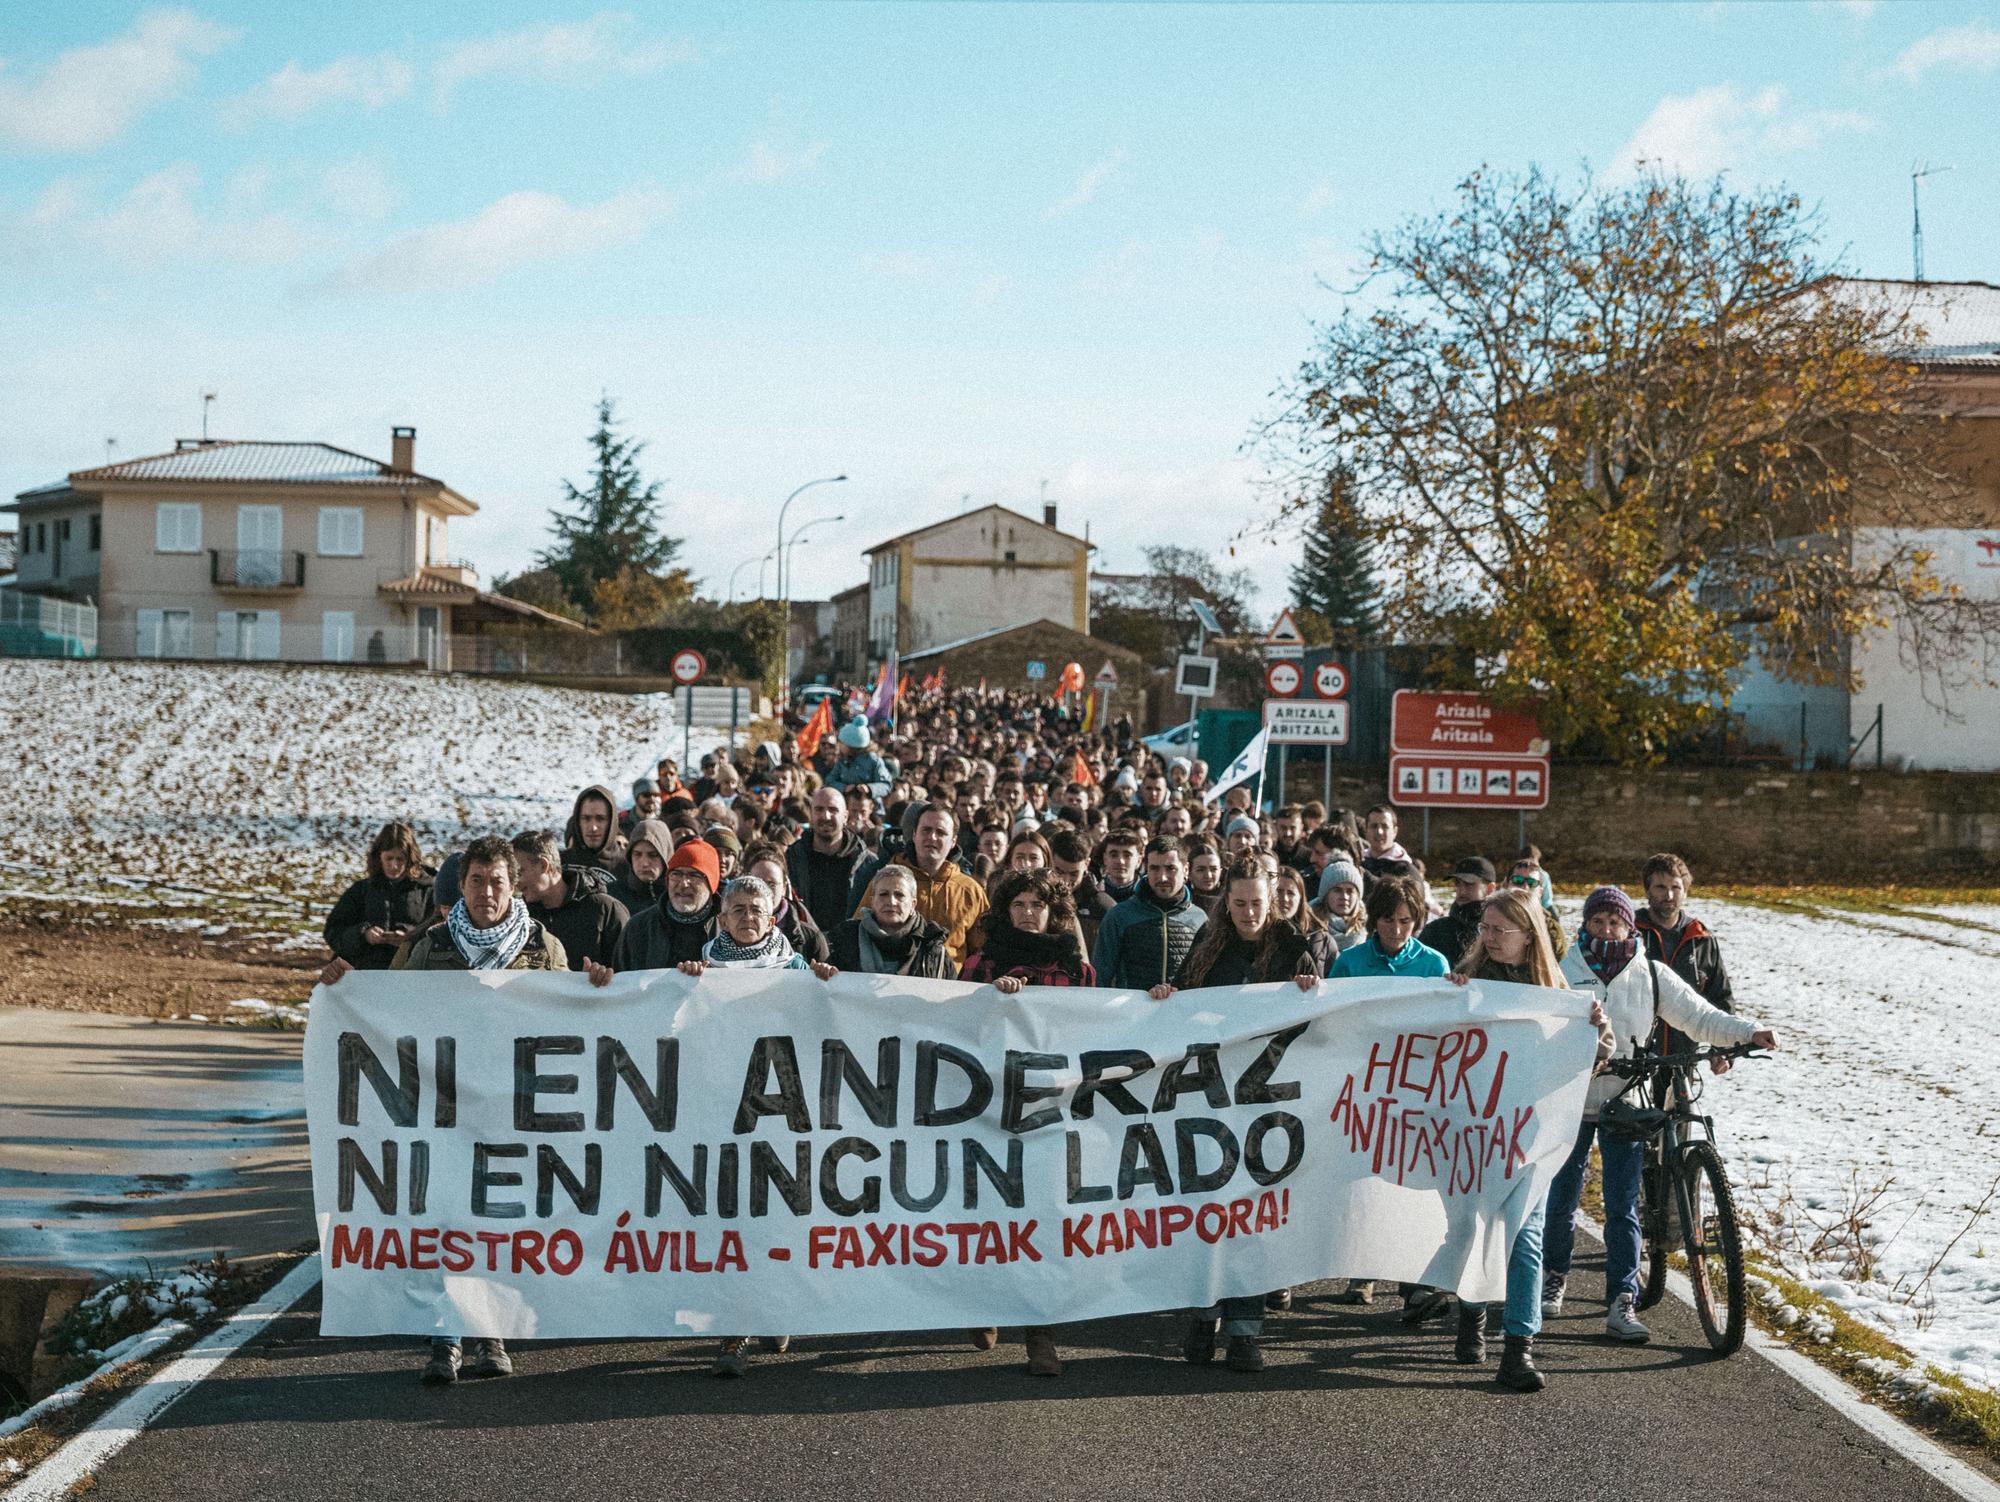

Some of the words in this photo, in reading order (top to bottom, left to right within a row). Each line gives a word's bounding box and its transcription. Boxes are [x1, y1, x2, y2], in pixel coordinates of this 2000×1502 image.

[1321, 676, 1342, 688] 40
[1275, 707, 1336, 719] ARIZALA
[1435, 702, 1491, 719] Arizala
[1271, 724, 1340, 736] ARITZALA
[1431, 727, 1494, 744] Aritzala
[338, 1032, 456, 1128] NI
[513, 1035, 680, 1132] EN
[733, 1020, 1311, 1135] ANDERAZ
[1330, 1073, 1534, 1197] ANTIFAXISTAK
[338, 1137, 431, 1216] NI
[471, 1141, 602, 1219] EN
[644, 1135, 1026, 1218] NINGUN
[1066, 1111, 1306, 1204] LADO
[331, 1223, 585, 1276] MAESTRO
[603, 1209, 749, 1274] ÁVILA
[808, 1219, 1043, 1270] FAXISTAK
[1062, 1187, 1290, 1259] KANPORA!
